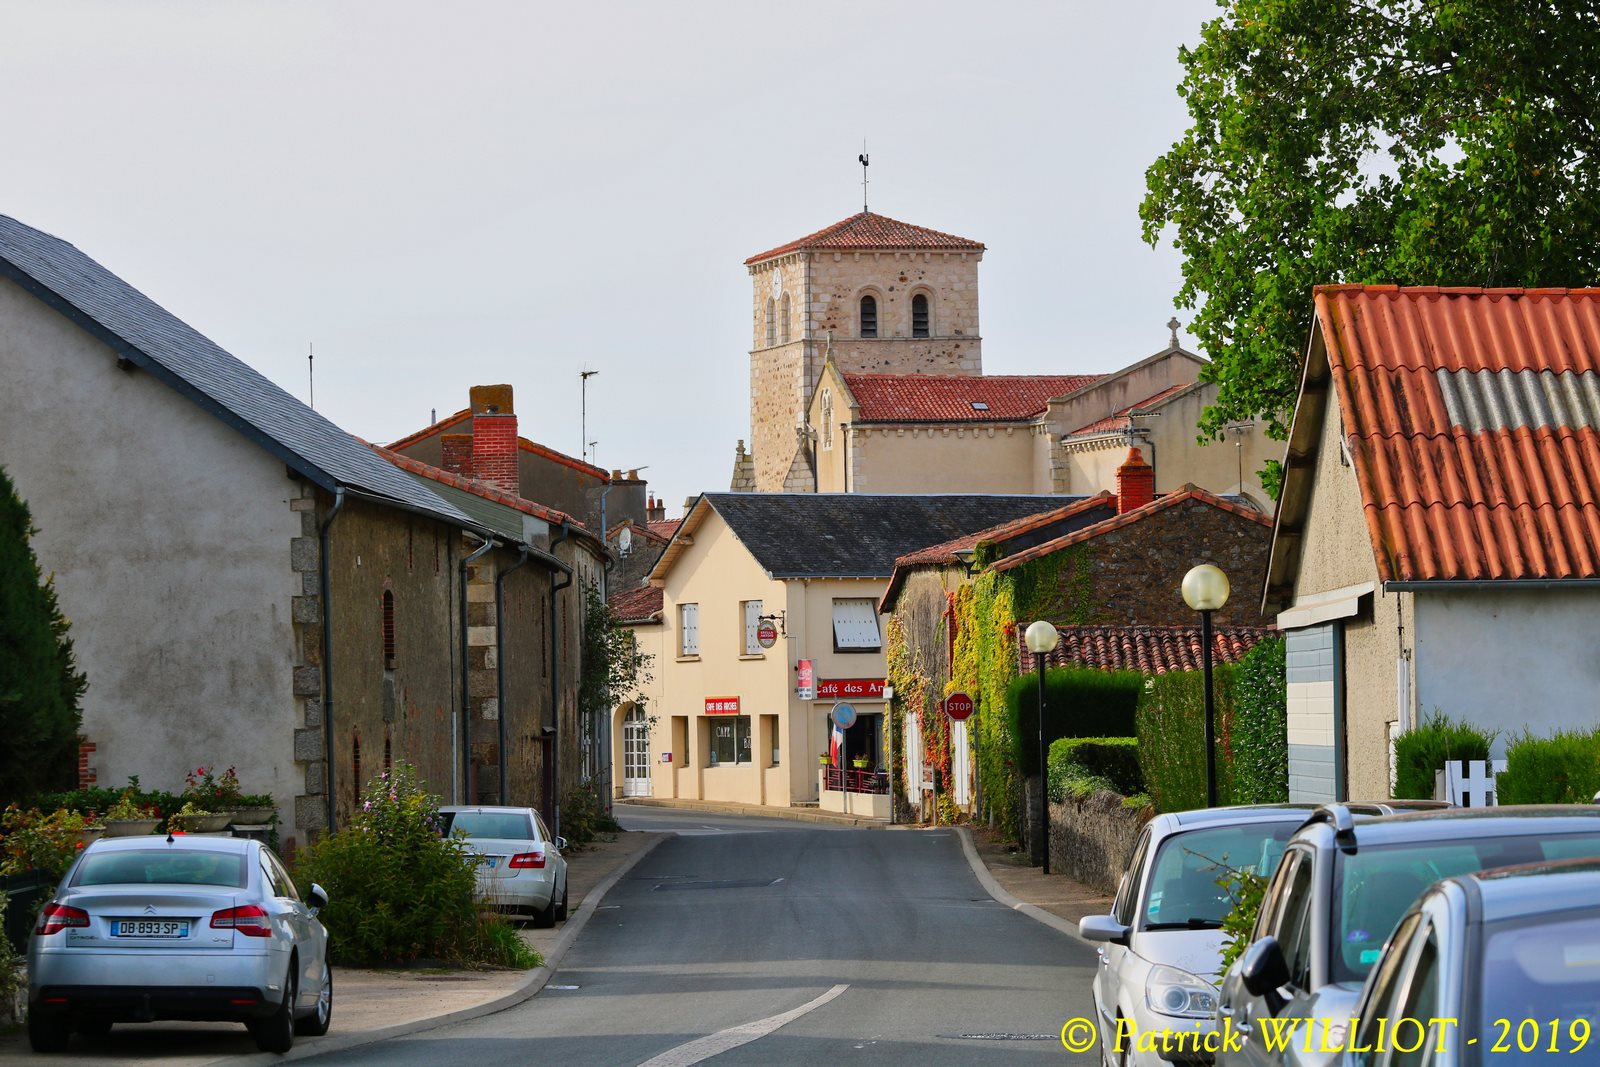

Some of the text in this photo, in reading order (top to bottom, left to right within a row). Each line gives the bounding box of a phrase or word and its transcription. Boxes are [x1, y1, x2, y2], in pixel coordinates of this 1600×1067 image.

[844, 683, 863, 693] des
[868, 682, 884, 693] Ar
[949, 702, 971, 711] STOP
[120, 922, 178, 934] DB-893-SP
